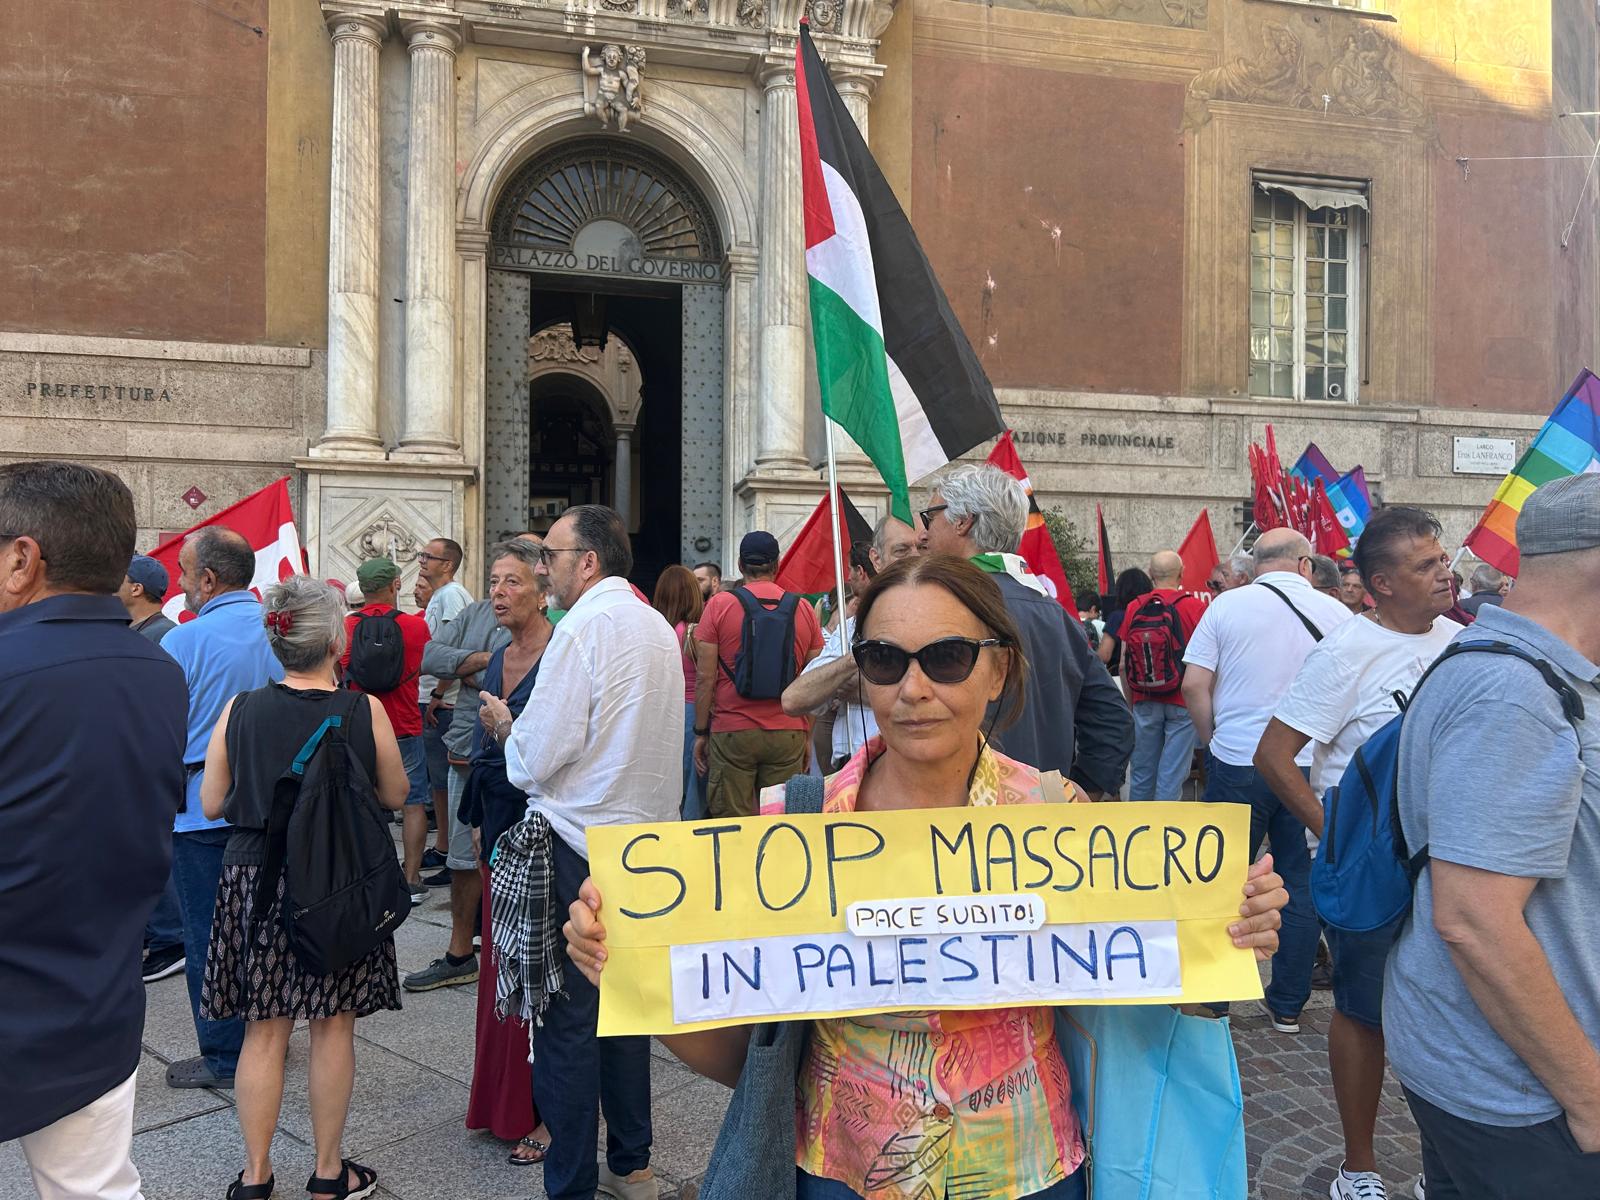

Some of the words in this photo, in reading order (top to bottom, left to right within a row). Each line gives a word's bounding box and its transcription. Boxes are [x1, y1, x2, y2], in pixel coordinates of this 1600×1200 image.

[494, 247, 578, 269] PALAZZO
[586, 254, 622, 273] DEL
[628, 258, 717, 280] GOVERNO
[26, 382, 172, 402] PREFETTURA
[1080, 433, 1175, 450] PROVINCIALE
[1471, 451, 1513, 461] LANFRANCO
[619, 821, 885, 920] STOP
[930, 821, 1225, 895] MASSACRO
[854, 905, 927, 929] PACE
[936, 902, 1035, 925] SUBITO!
[701, 946, 761, 1000] IN
[792, 925, 1148, 993] PALESTINA
